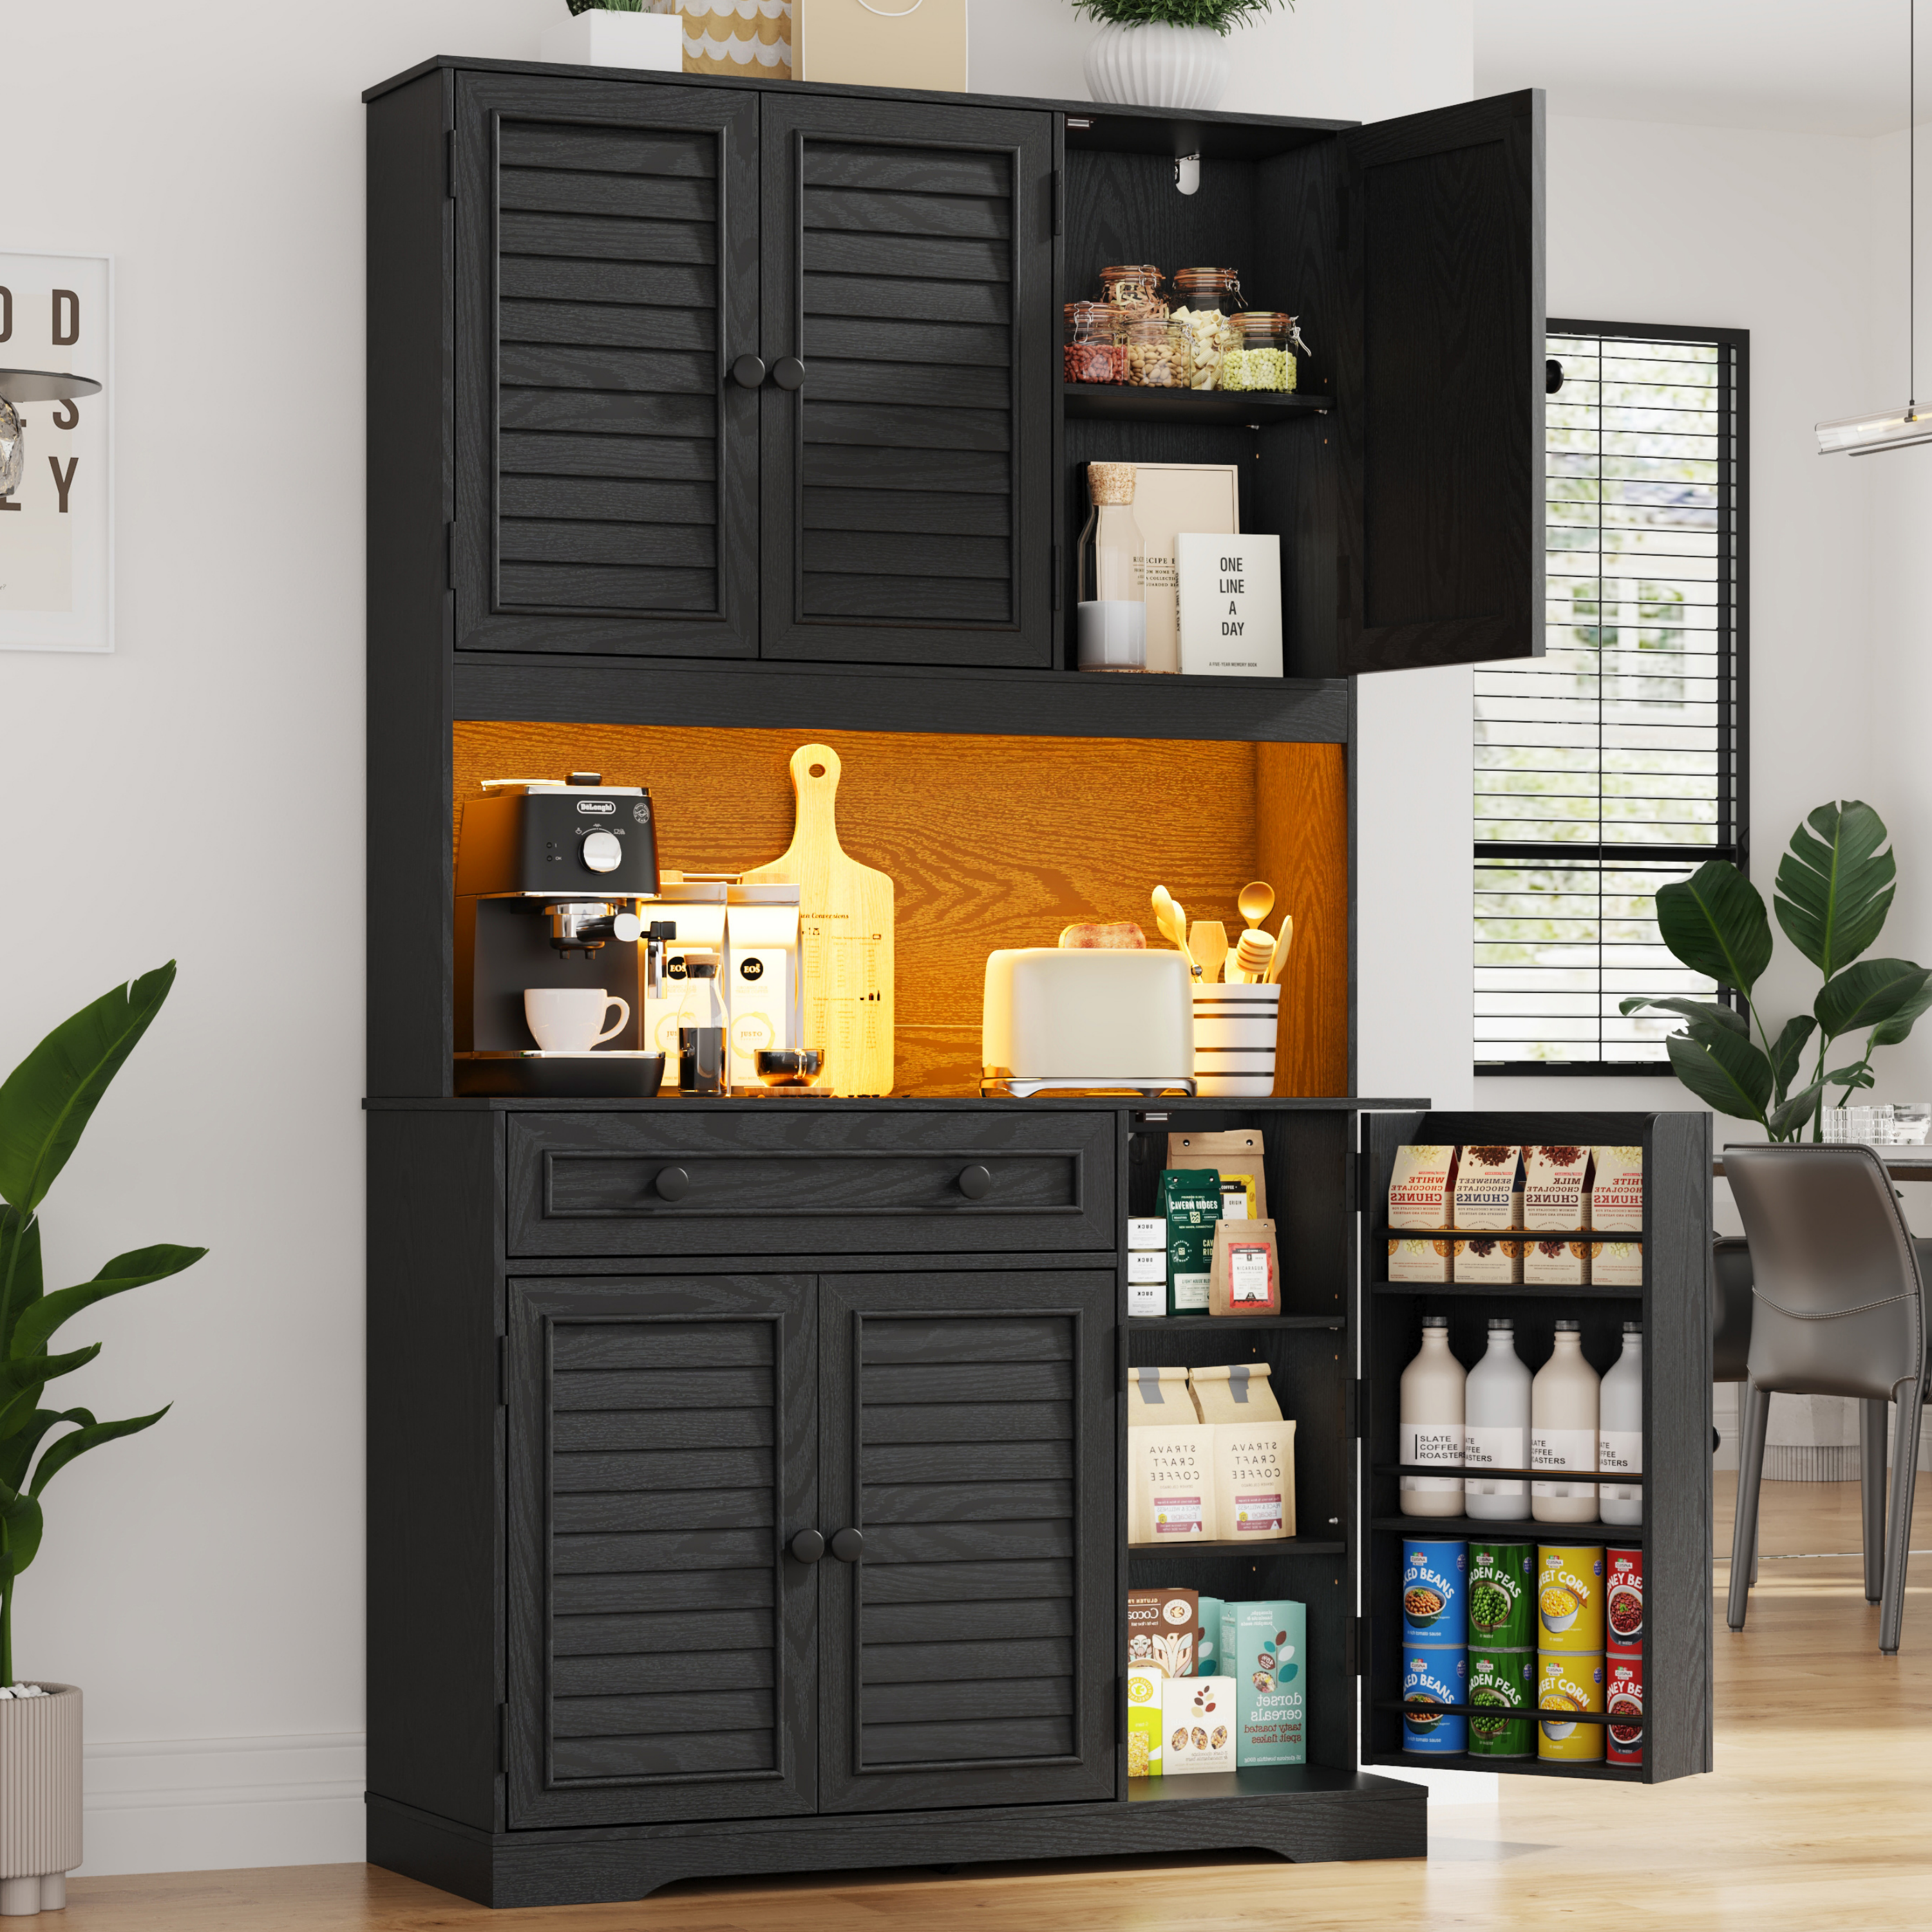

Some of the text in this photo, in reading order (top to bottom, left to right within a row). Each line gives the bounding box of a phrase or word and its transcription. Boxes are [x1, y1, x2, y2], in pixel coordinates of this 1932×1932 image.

[1220, 557, 1243, 572] ONE
[1220, 579, 1245, 594] LINE
[1229, 601, 1236, 615] A
[1221, 622, 1245, 636] DAY
[1171, 1200, 1218, 1209] CAVERN RIDGES
[1420, 1567, 1454, 1598] BEANS
[1495, 1570, 1521, 1598] PEAS
[1558, 1571, 1590, 1600] CORN
[1420, 1674, 1454, 1704] BEANS
[1495, 1677, 1521, 1705] PEAS
[1558, 1679, 1590, 1707] CORN
